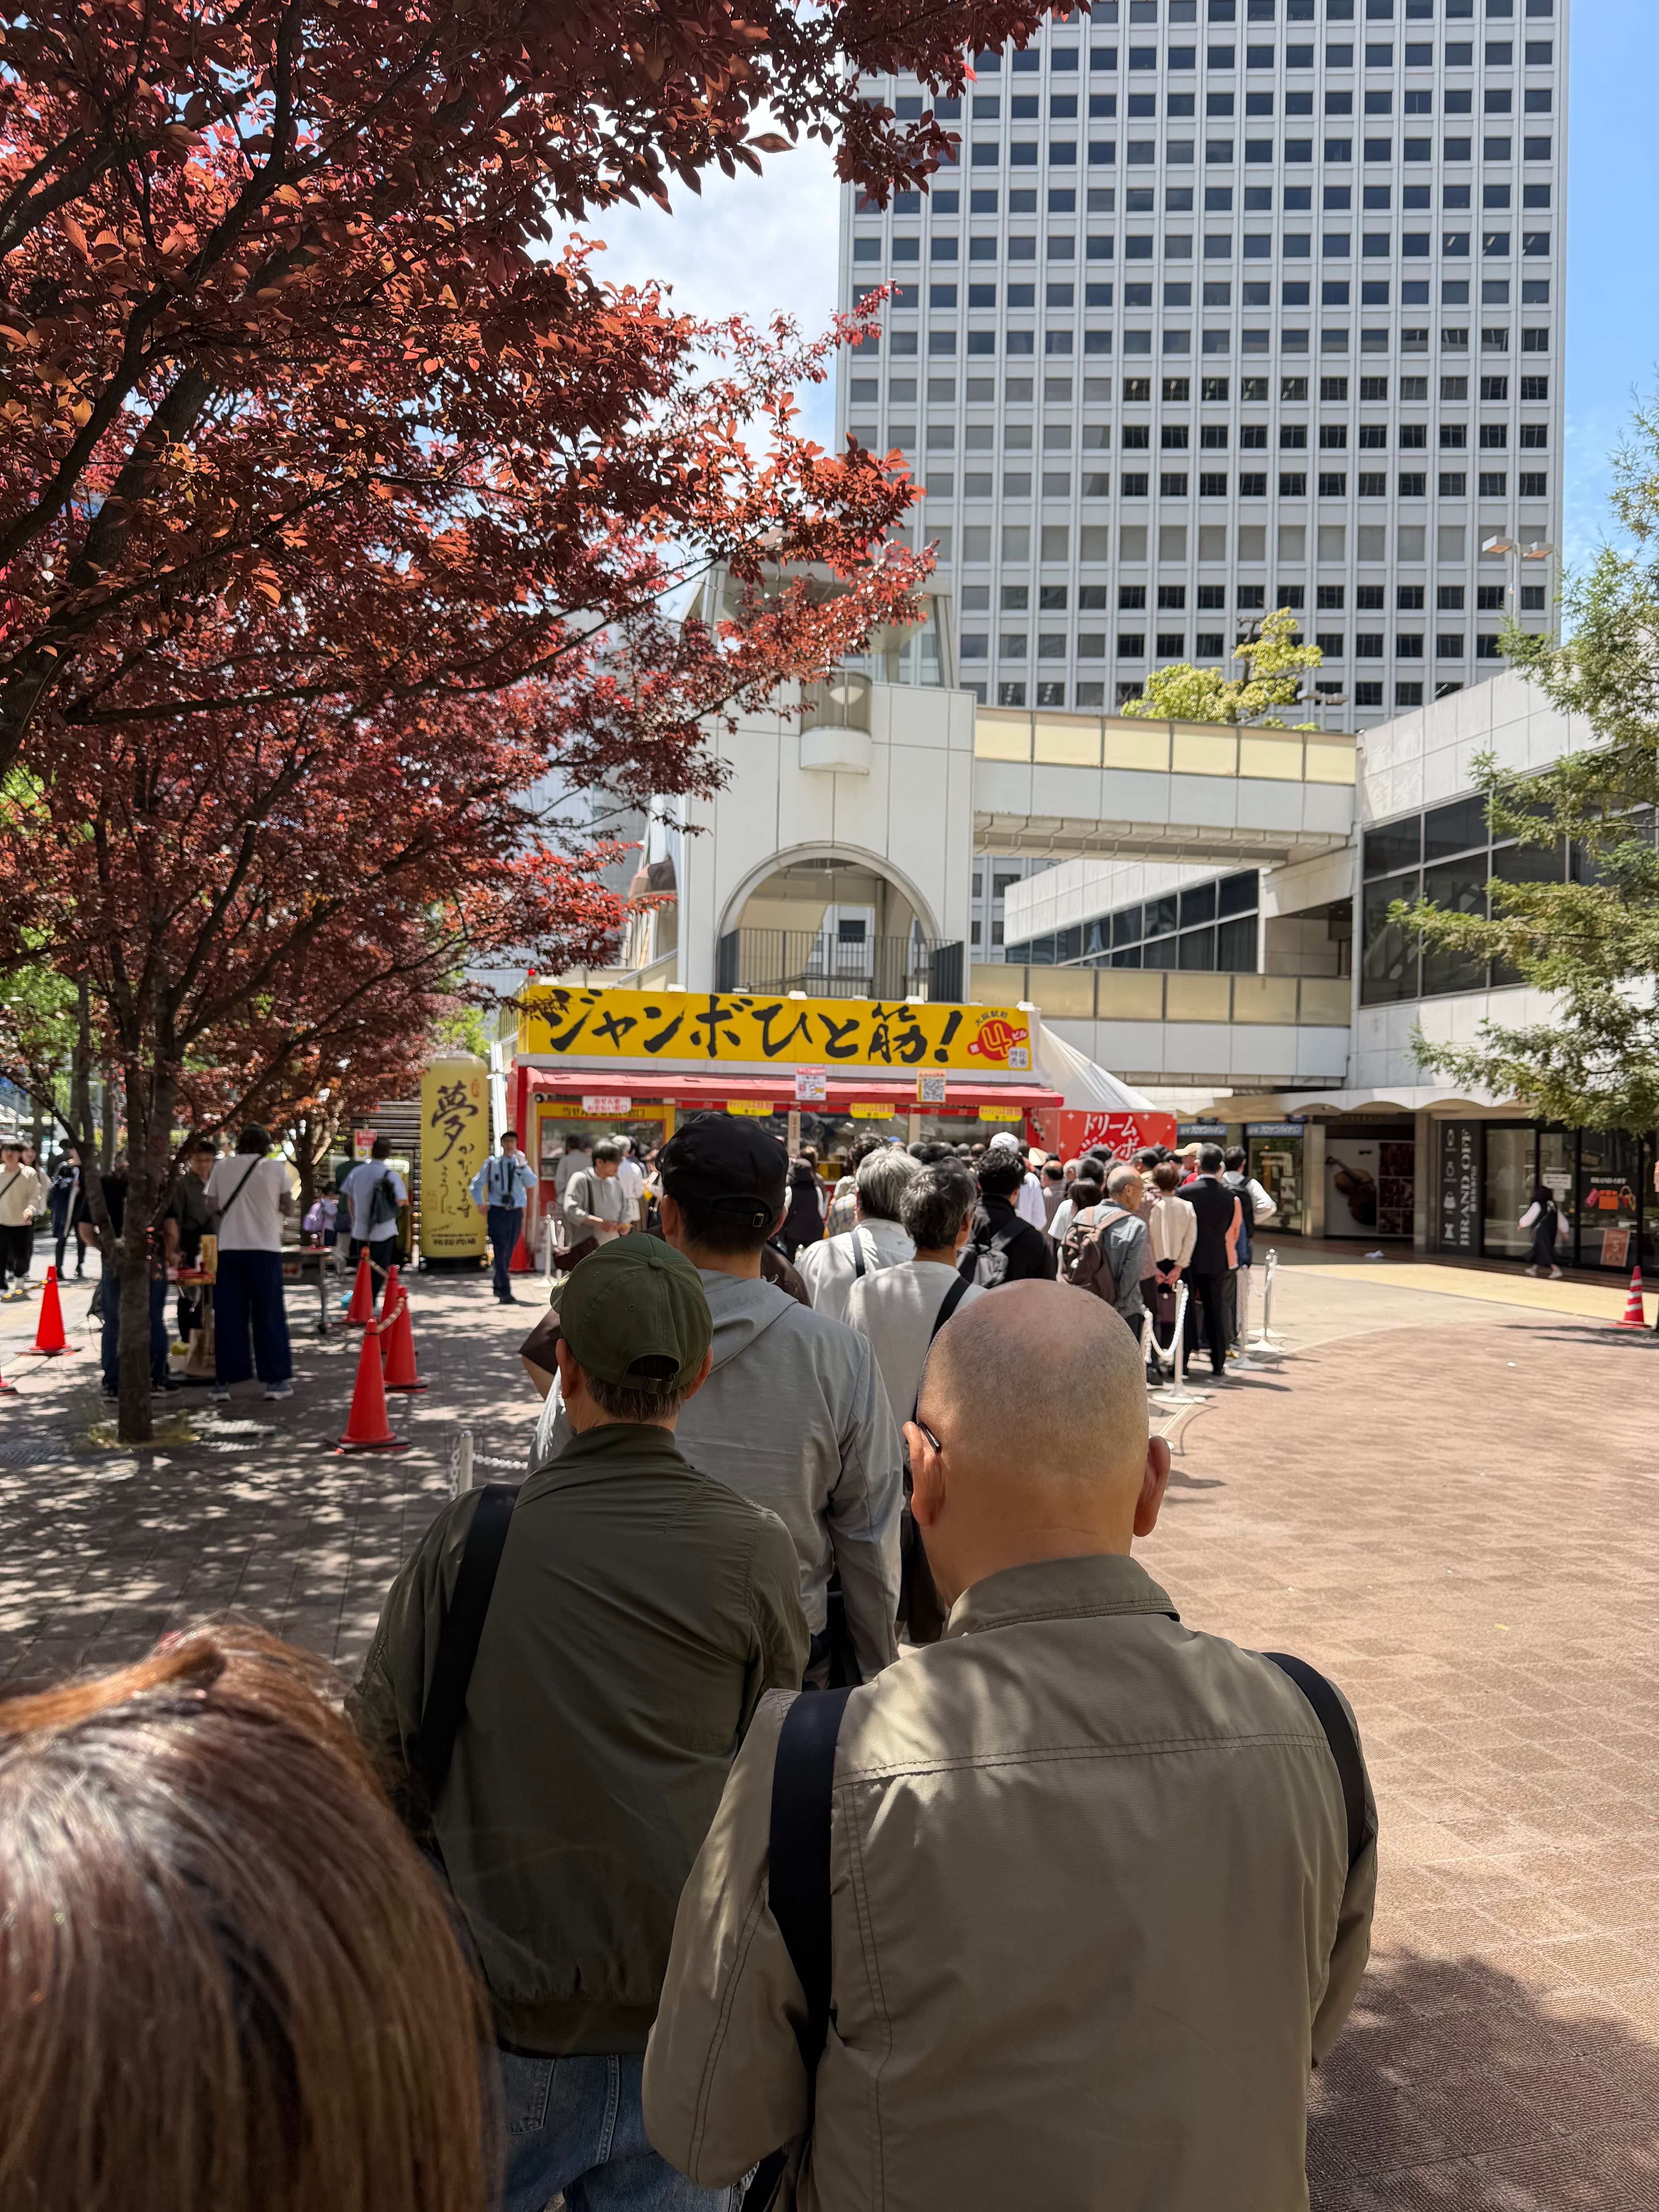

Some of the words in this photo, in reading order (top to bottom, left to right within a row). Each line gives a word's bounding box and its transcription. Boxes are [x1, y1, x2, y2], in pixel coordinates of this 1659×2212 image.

[431, 1080, 479, 1161] 夢
[1084, 1113, 1137, 1137] ドリーム
[1461, 1128, 1472, 1170] OFF
[1460, 1175, 1471, 1246] BRAND
